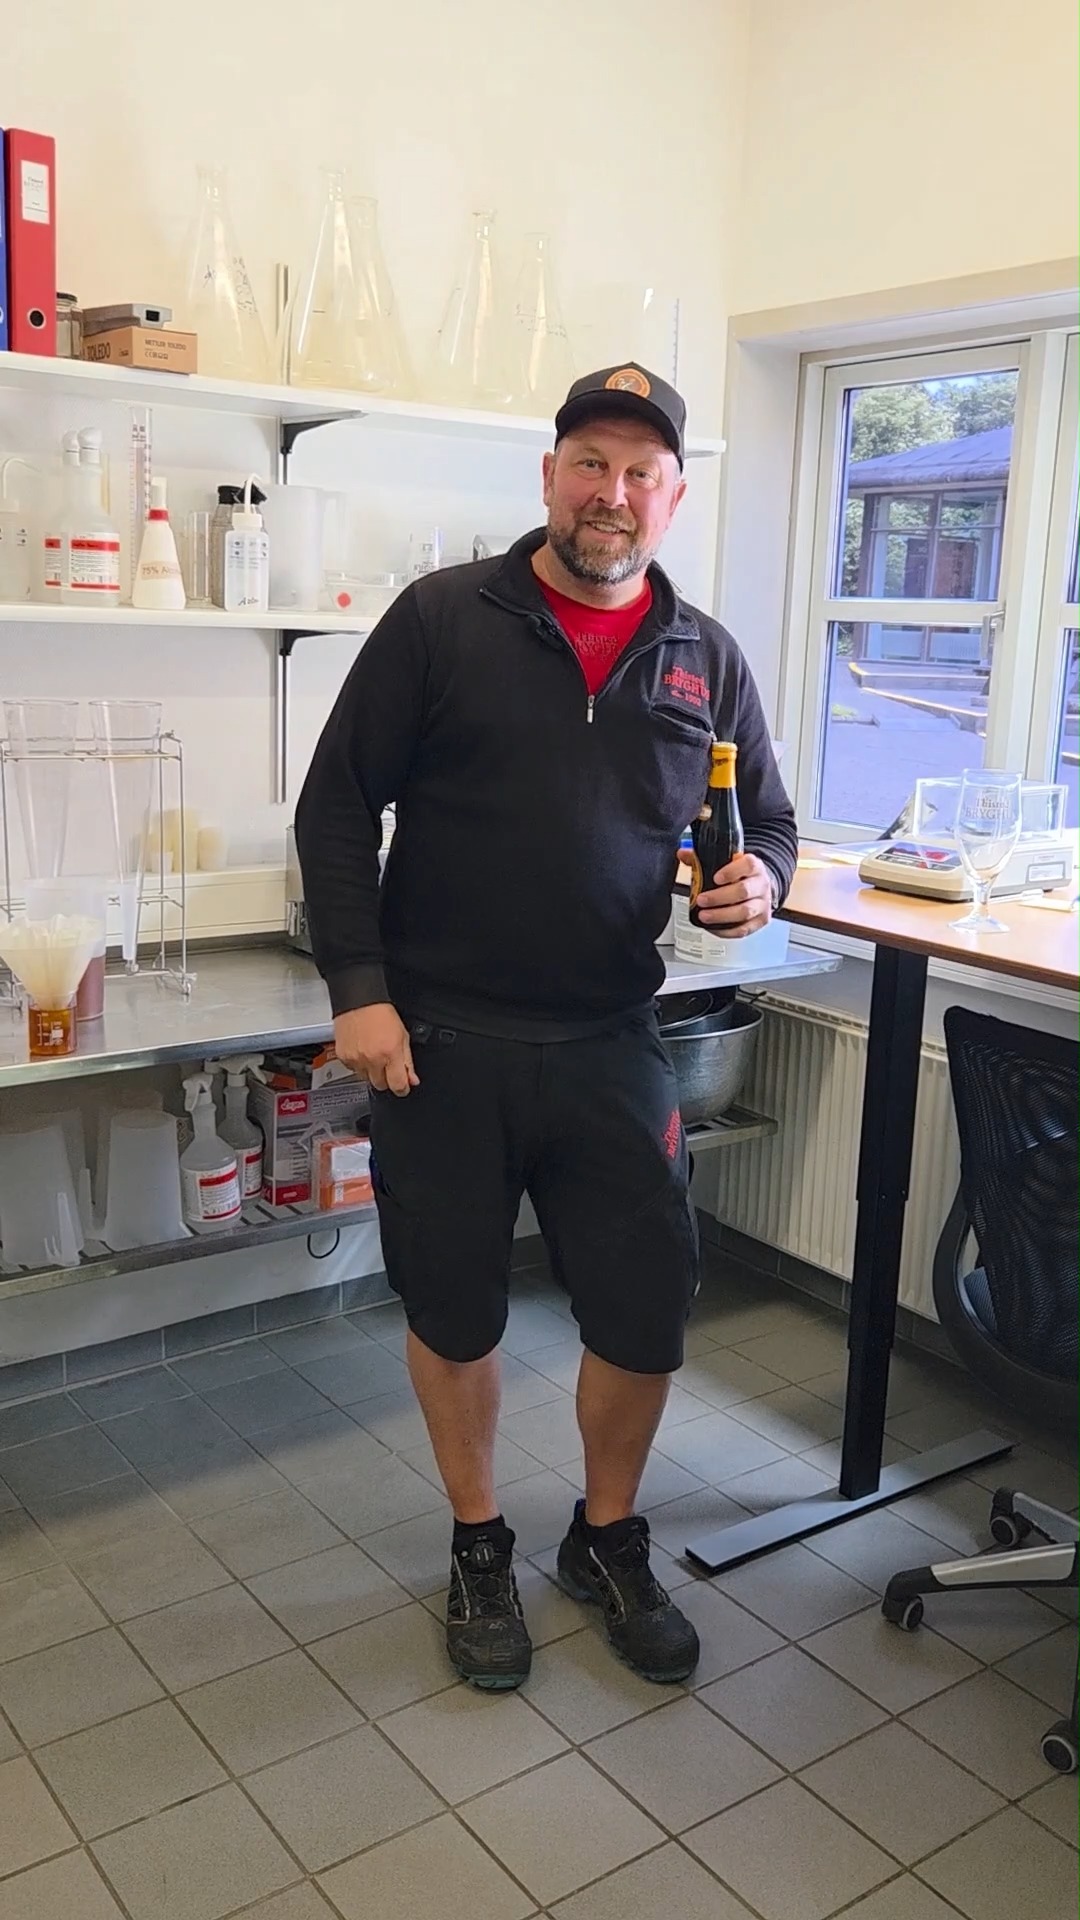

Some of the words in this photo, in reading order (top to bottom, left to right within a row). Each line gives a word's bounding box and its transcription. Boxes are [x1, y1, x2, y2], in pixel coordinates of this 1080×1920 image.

[87, 342, 111, 361] TOLEDO
[167, 341, 187, 351] TOLEDO
[672, 665, 705, 686] Thisted
